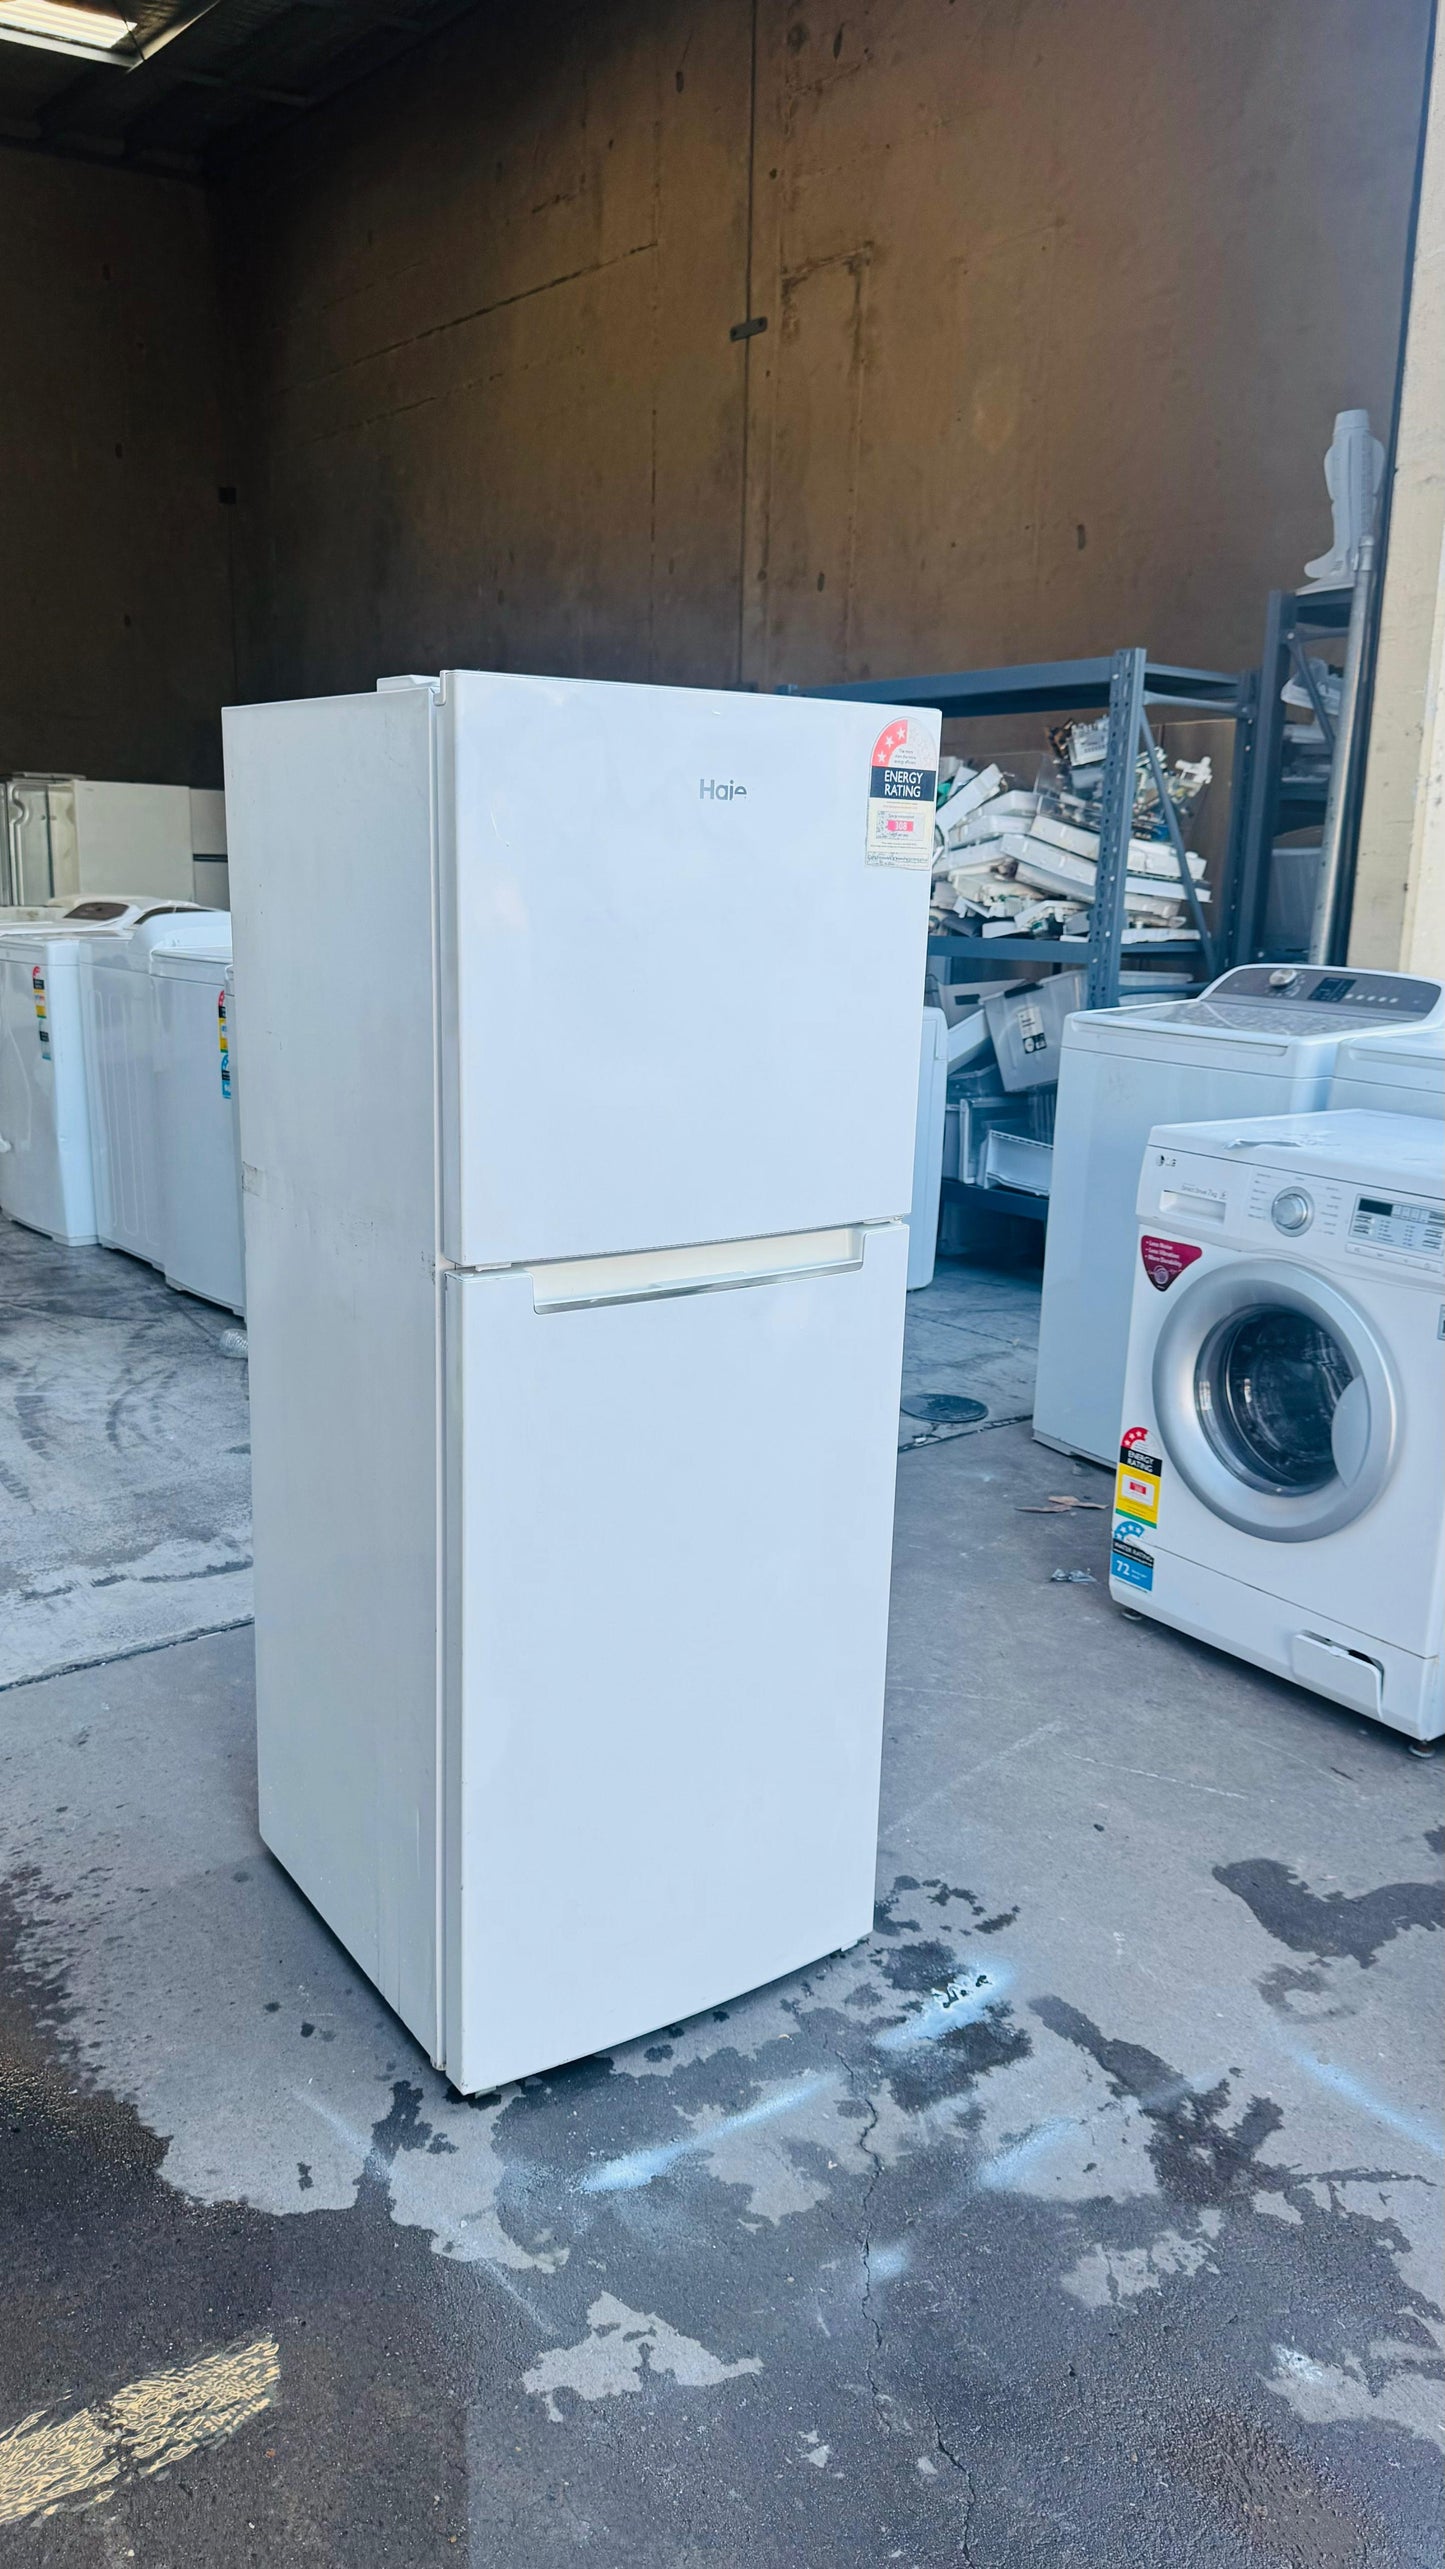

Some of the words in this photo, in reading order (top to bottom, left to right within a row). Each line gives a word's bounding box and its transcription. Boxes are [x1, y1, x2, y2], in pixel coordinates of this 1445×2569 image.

[884, 769, 923, 785] ENERGY
[884, 783, 921, 798] RATING
[1116, 1560, 1130, 1576] 72
